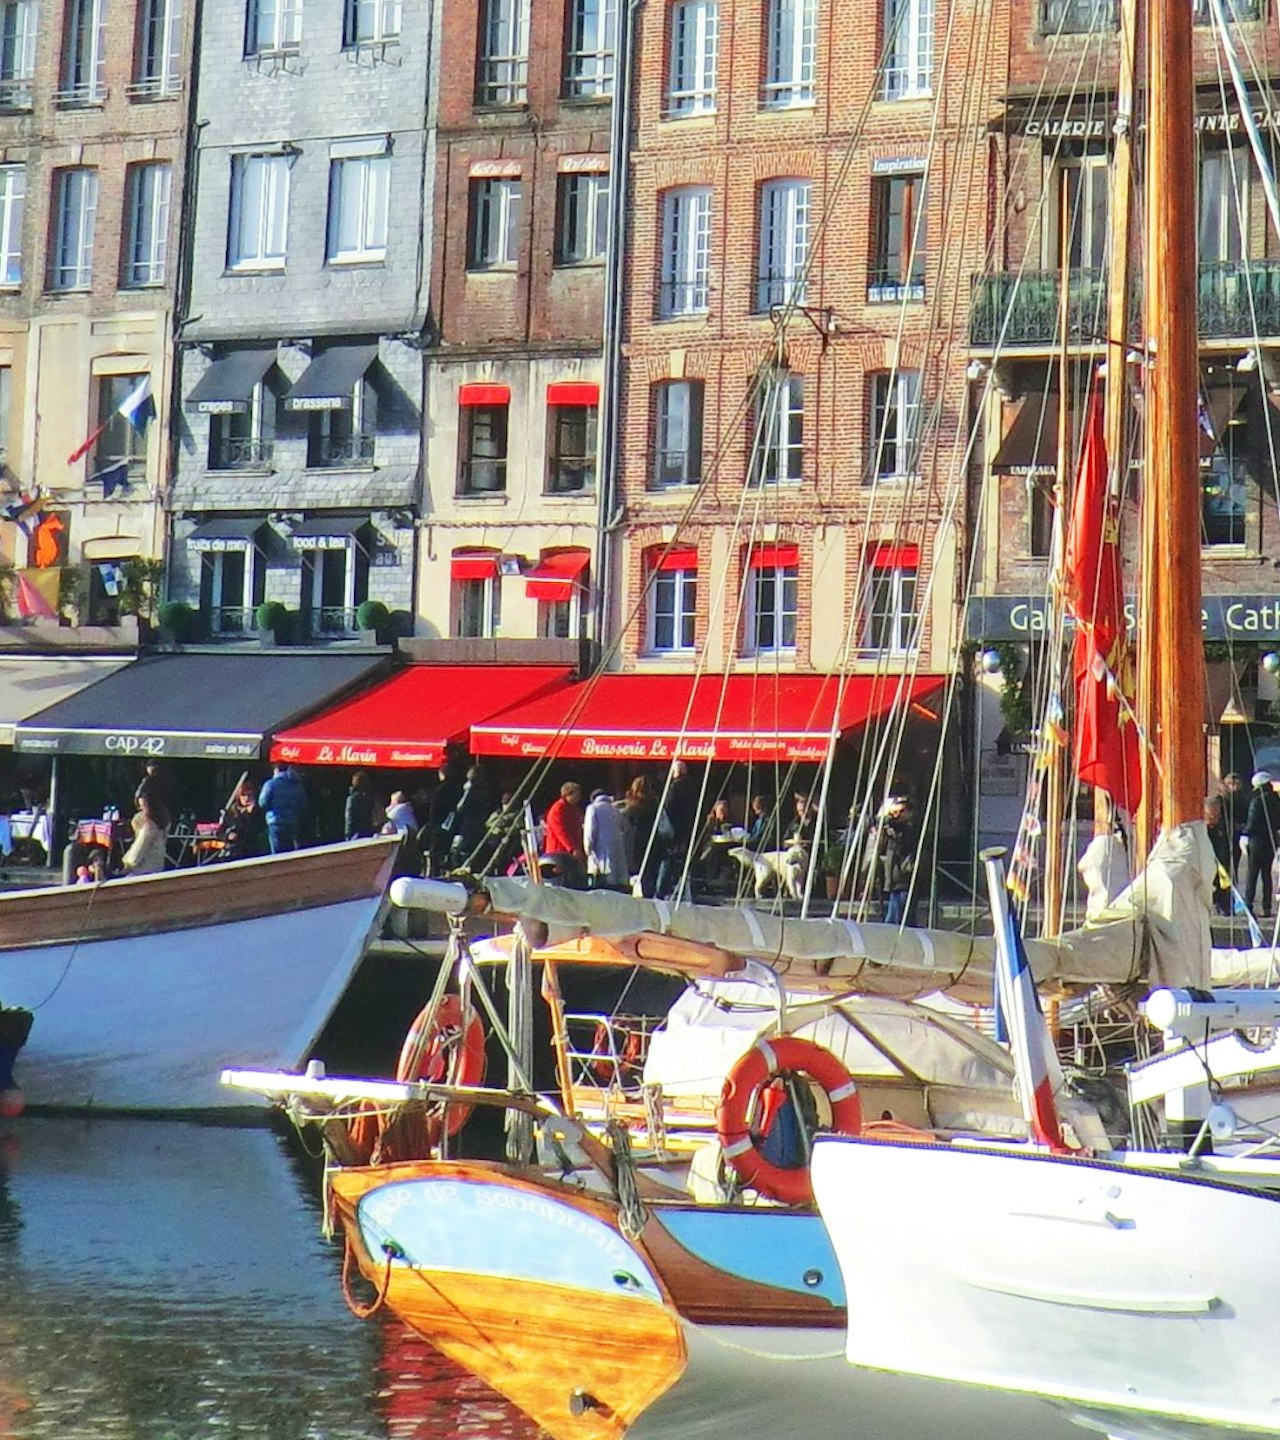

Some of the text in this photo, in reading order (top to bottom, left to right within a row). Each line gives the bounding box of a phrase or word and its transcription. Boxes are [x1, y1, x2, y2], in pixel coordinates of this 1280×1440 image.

[1025, 120, 1105, 136] GALERIE
[873, 158, 929, 173] Inspiration
[292, 397, 342, 409] brasserie
[186, 538, 209, 550] fruits
[211, 539, 226, 550] de
[293, 536, 317, 548] food
[329, 536, 346, 548] tea
[105, 736, 165, 755] CAP 42
[501, 734, 519, 746] Café
[227, 743, 237, 754] de
[280, 746, 301, 757] Café
[581, 738, 716, 757] Brasserie Le Marin
[316, 746, 377, 763] Le Marin
